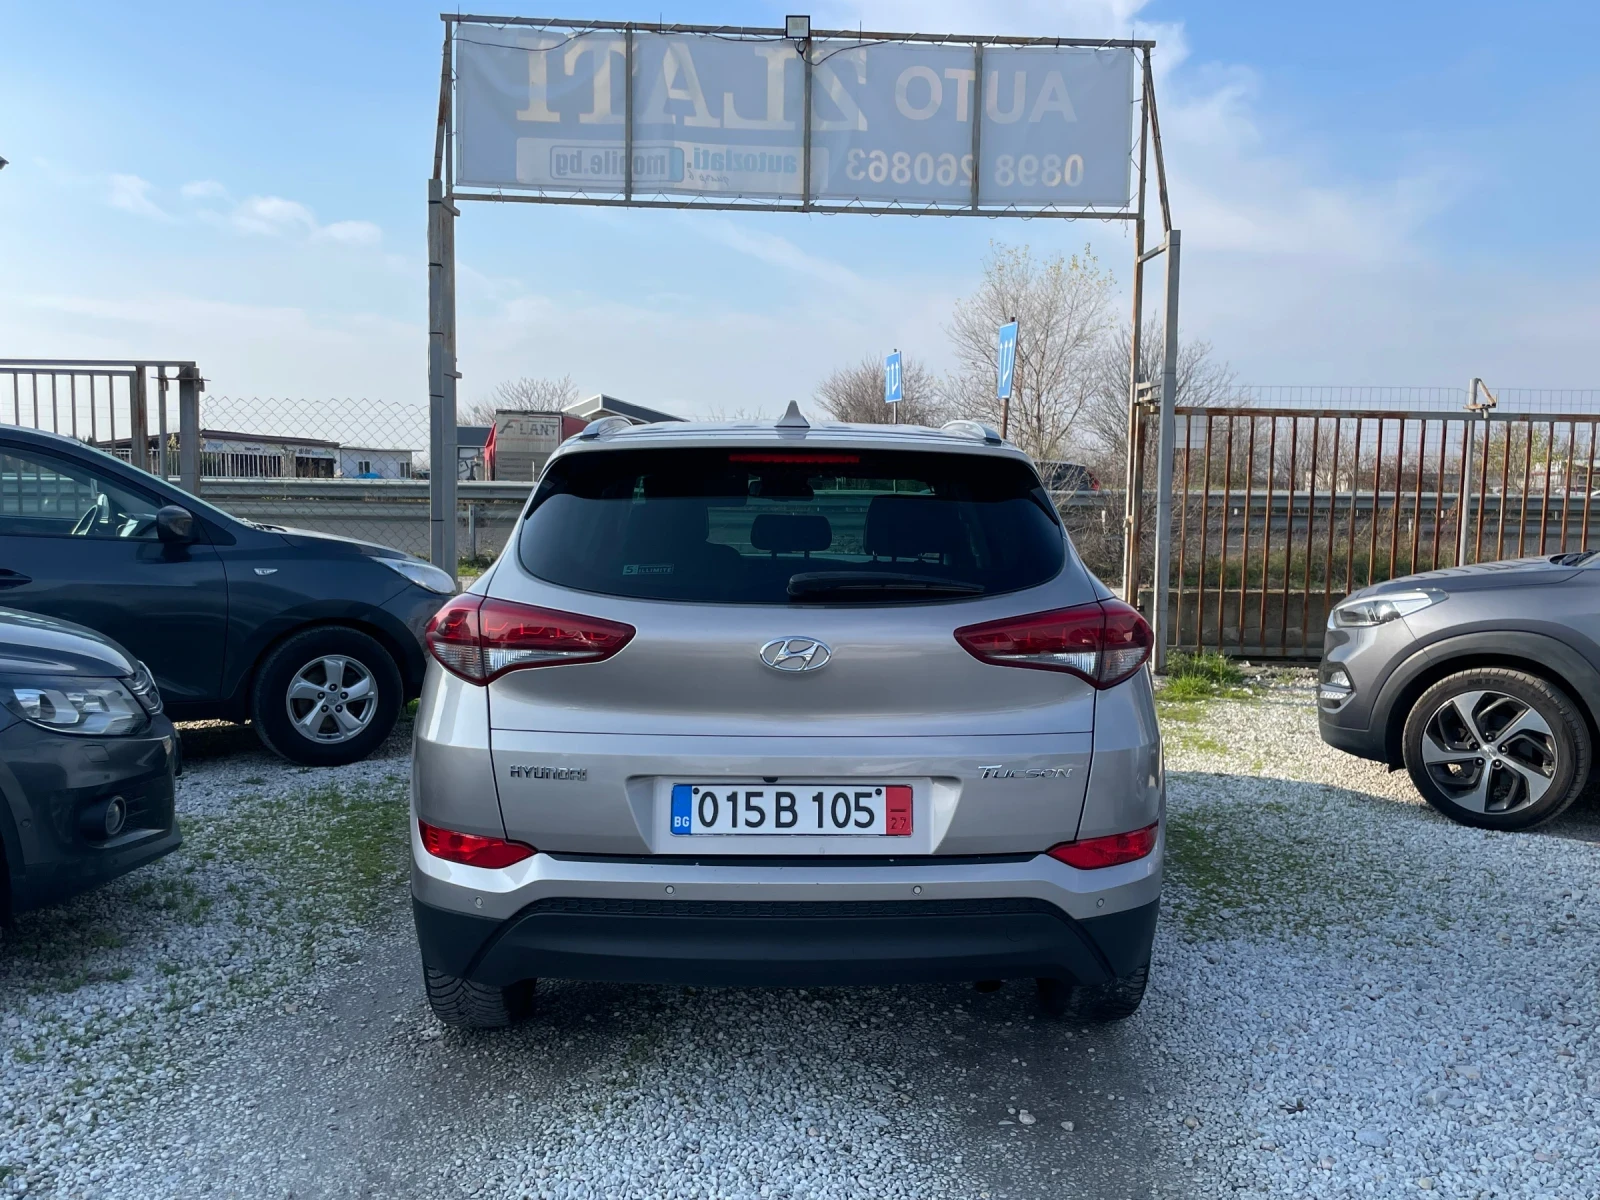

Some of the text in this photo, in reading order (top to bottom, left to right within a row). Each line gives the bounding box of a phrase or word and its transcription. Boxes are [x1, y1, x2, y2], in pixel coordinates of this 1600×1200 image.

[510, 764, 588, 781] HYUNDAI
[673, 816, 690, 827] BG
[698, 791, 767, 828] 015
[812, 791, 875, 828] 105
